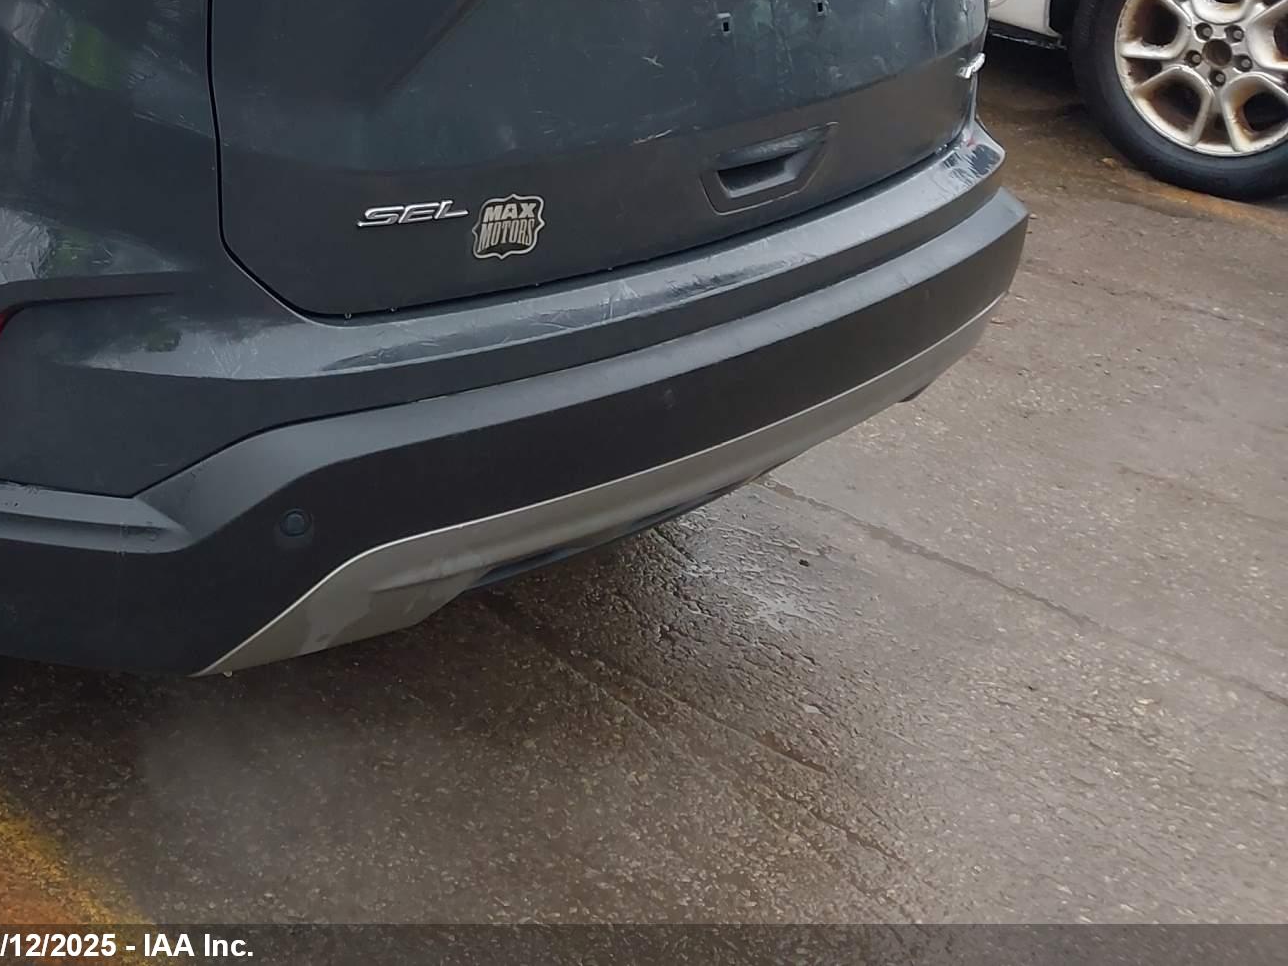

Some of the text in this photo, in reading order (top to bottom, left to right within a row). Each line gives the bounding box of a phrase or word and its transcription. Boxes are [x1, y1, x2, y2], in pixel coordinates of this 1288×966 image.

[357, 200, 468, 227] SEL
[483, 202, 537, 223] MAX
[477, 219, 535, 253] MOTORS
